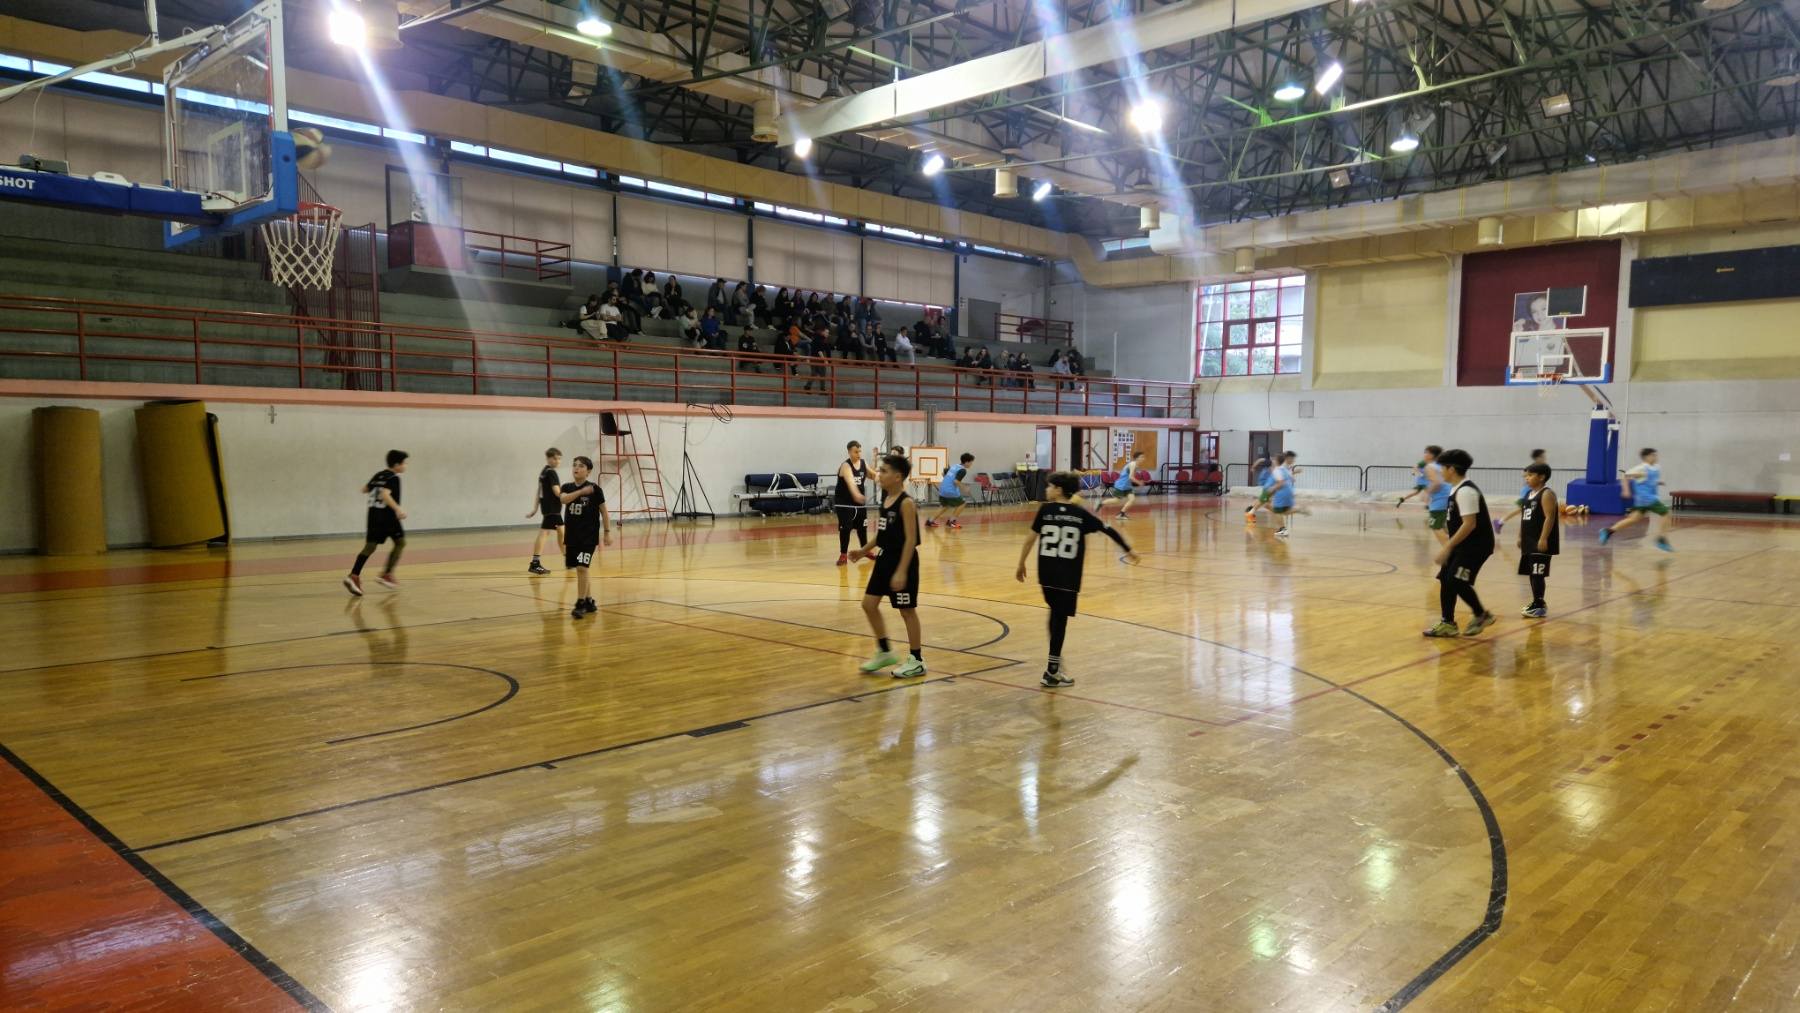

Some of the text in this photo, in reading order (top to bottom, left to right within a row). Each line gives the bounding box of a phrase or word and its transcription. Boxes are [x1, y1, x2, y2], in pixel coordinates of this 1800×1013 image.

[569, 503, 582, 515] 46
[1040, 524, 1080, 559] 28
[577, 551, 591, 565] 46
[1532, 562, 1546, 575] 12
[896, 592, 910, 605] 33
